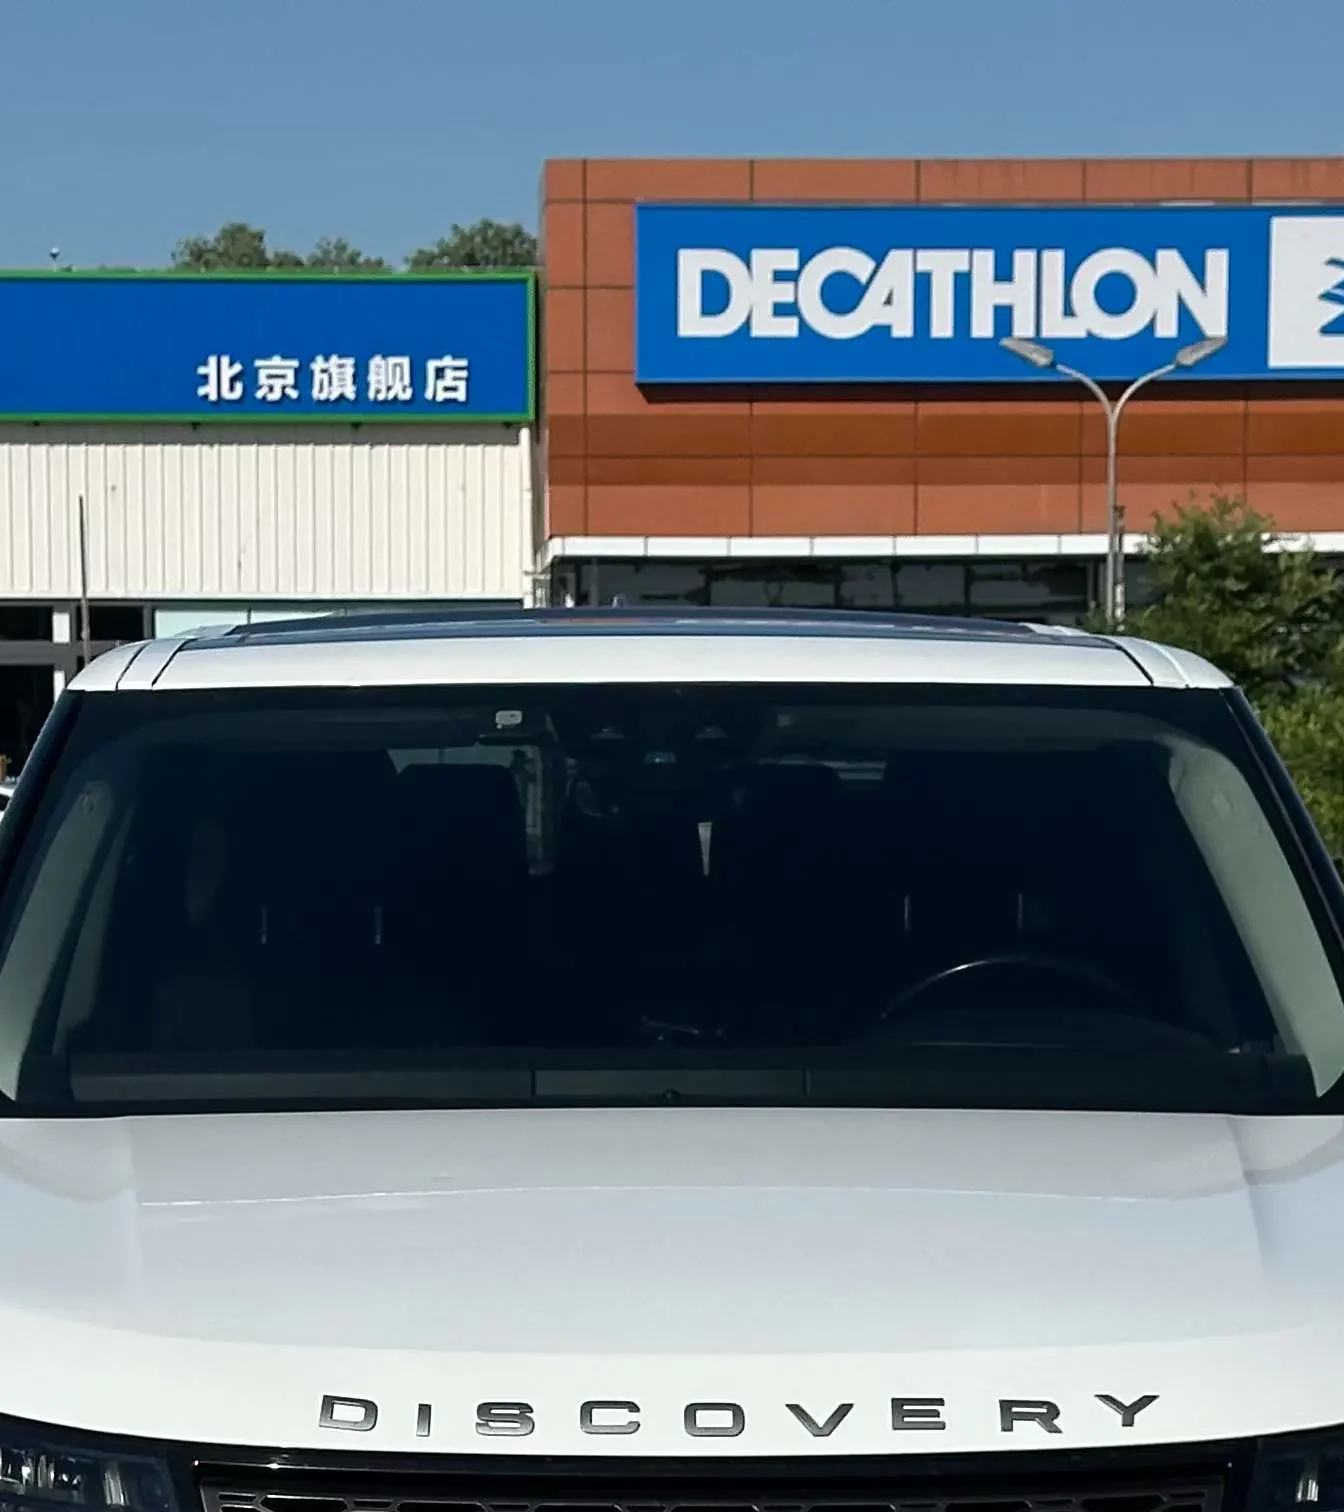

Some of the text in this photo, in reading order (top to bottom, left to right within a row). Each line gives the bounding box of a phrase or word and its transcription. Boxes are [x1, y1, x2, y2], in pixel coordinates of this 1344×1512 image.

[677, 247, 1230, 338] DECATHLON
[197, 355, 468, 402] 北京旗舰店
[319, 1394, 1160, 1438] DISCOVERY
